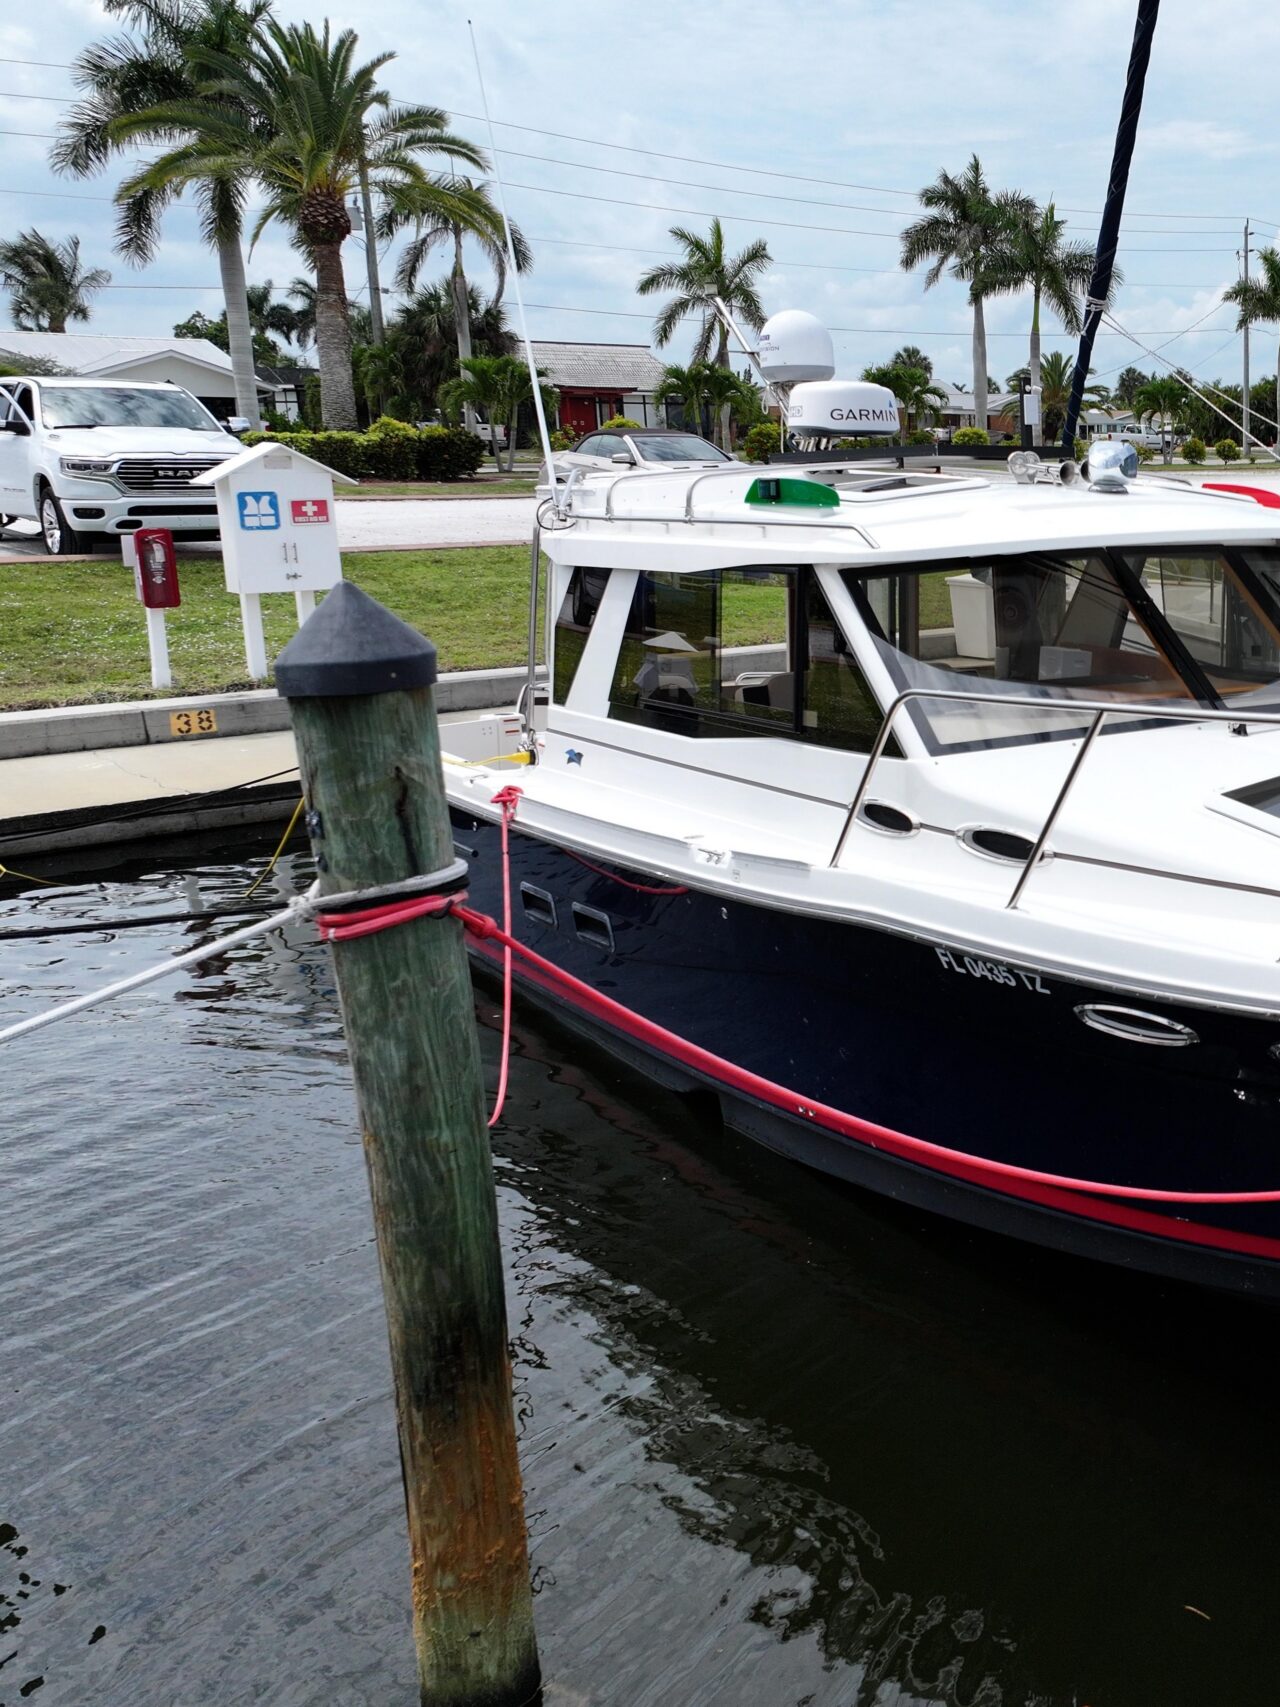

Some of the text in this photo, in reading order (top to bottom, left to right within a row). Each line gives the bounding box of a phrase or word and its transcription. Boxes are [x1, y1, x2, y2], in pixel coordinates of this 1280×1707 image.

[830, 408, 896, 421] GARMIN
[176, 710, 213, 734] 38
[935, 947, 1051, 995] FL 0435 TZ
